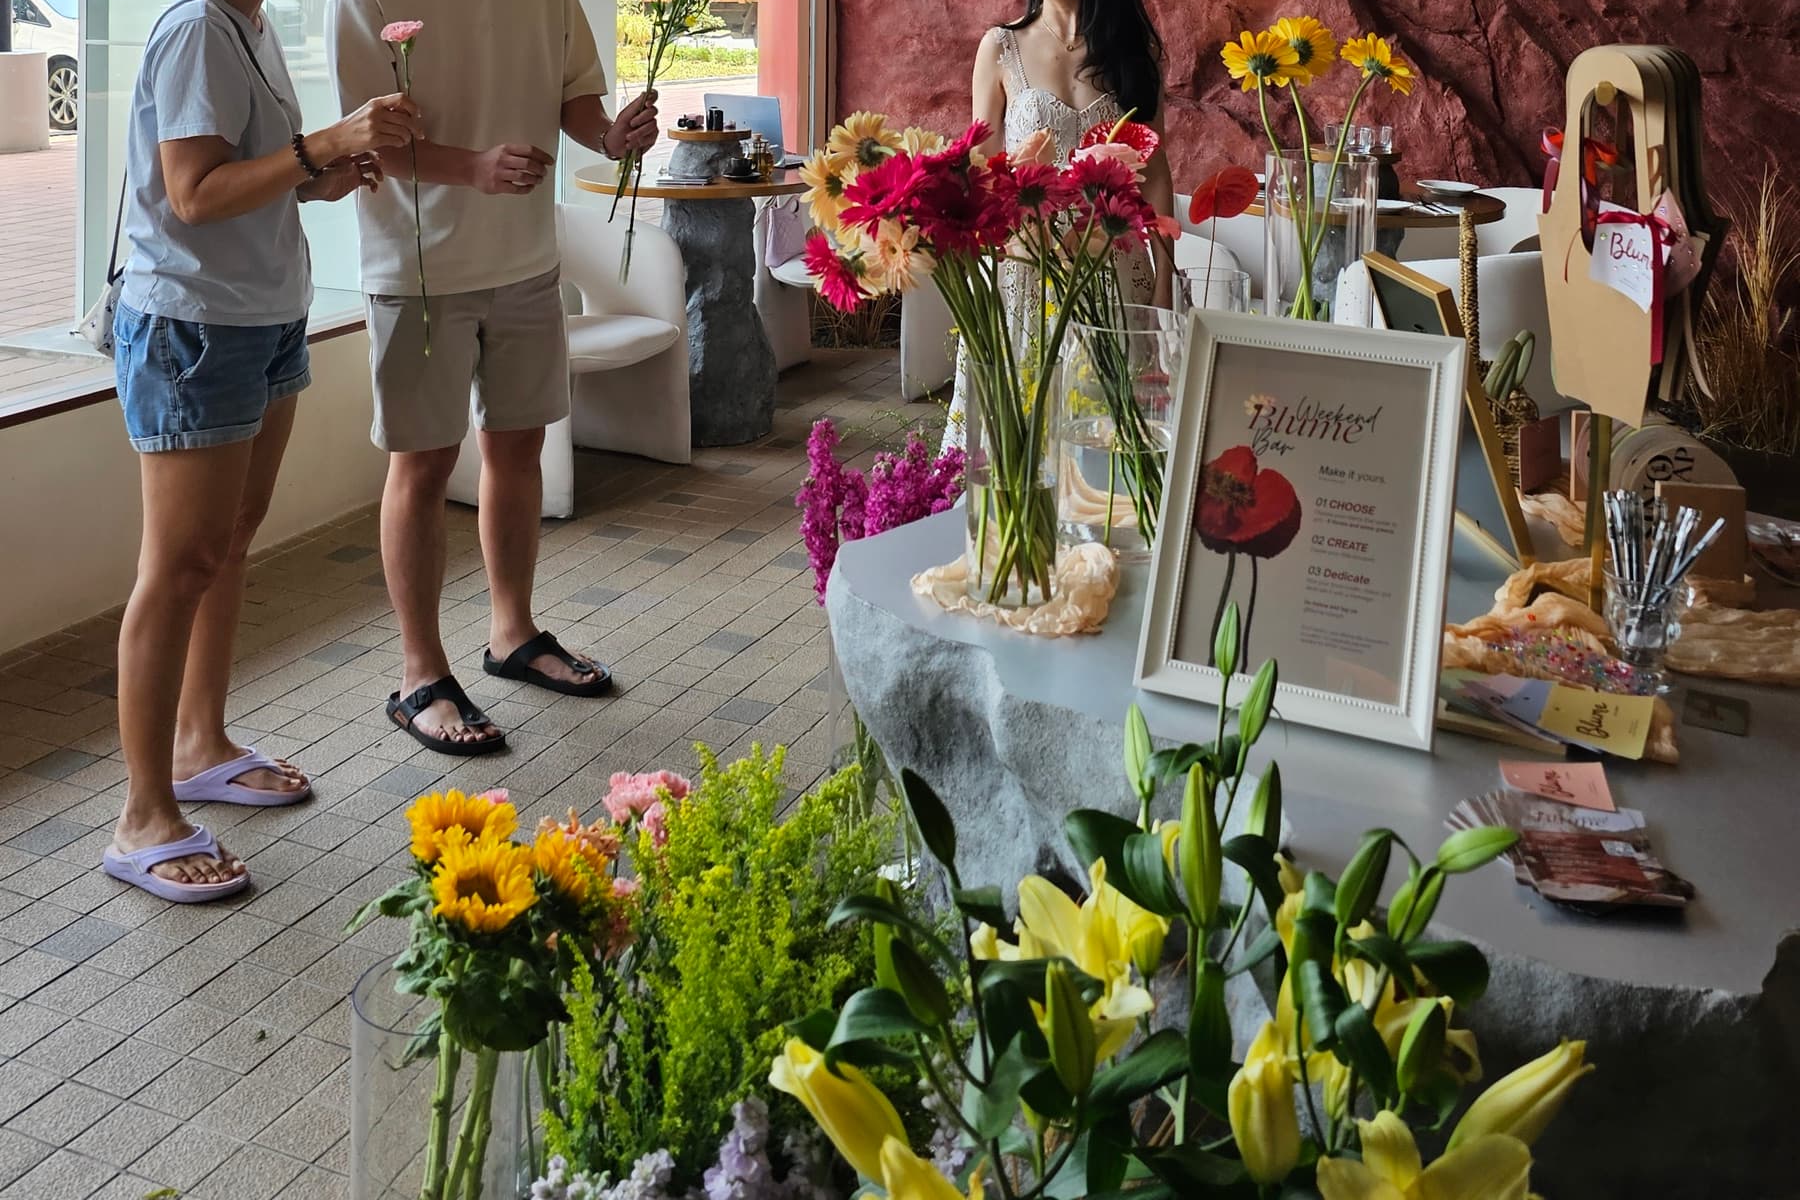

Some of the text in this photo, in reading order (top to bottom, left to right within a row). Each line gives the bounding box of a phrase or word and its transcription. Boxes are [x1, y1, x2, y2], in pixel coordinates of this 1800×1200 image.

[1609, 231, 1653, 271] Blum
[1248, 403, 1363, 444] Blume
[1296, 396, 1382, 433] Weekend
[1252, 427, 1295, 456] Bar
[1318, 465, 1345, 478] Make
[1348, 469, 1355, 480] it
[1315, 497, 1376, 515] 01 CHOOSE
[1312, 534, 1369, 553] 02 CREATE
[1308, 566, 1371, 585] 03 Dedicate
